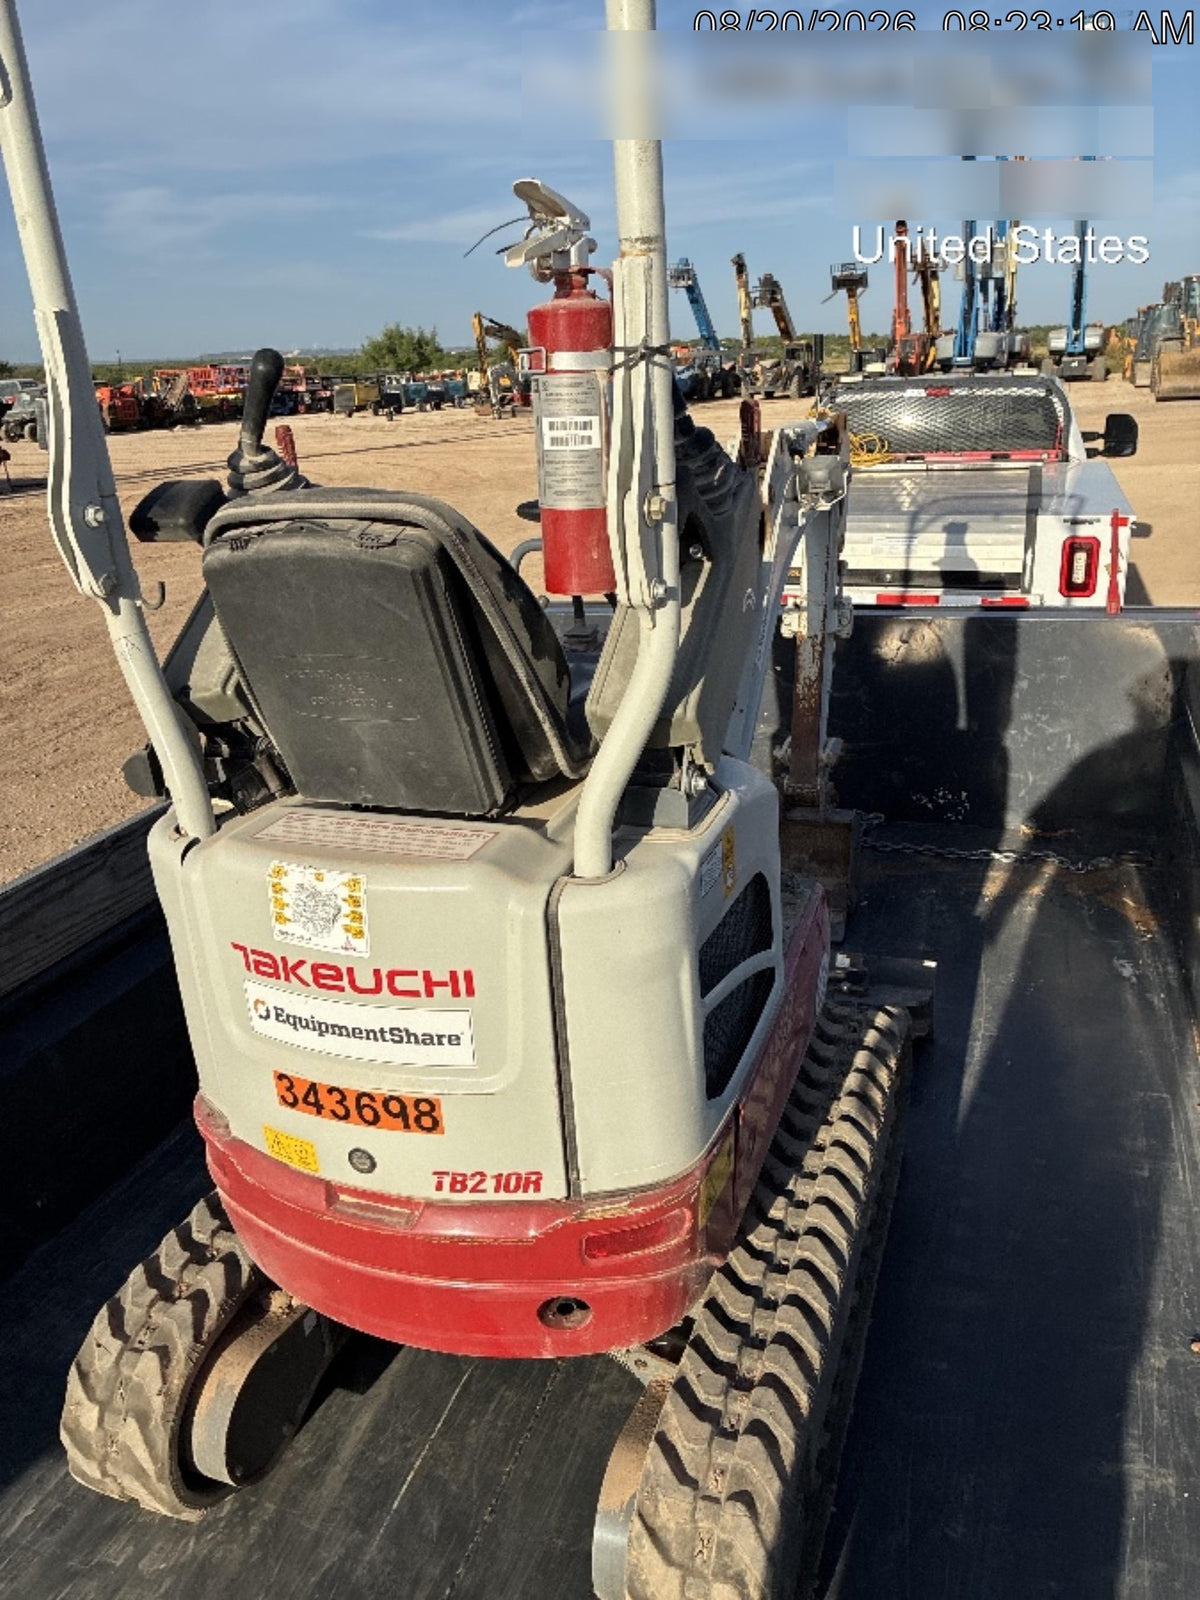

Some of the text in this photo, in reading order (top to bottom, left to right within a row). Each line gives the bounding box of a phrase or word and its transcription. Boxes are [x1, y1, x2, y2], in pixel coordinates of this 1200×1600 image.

[273, 1006, 462, 1046] EquipmentShare
[276, 1073, 441, 1133] 343698
[432, 1171, 543, 1194] TB210R
